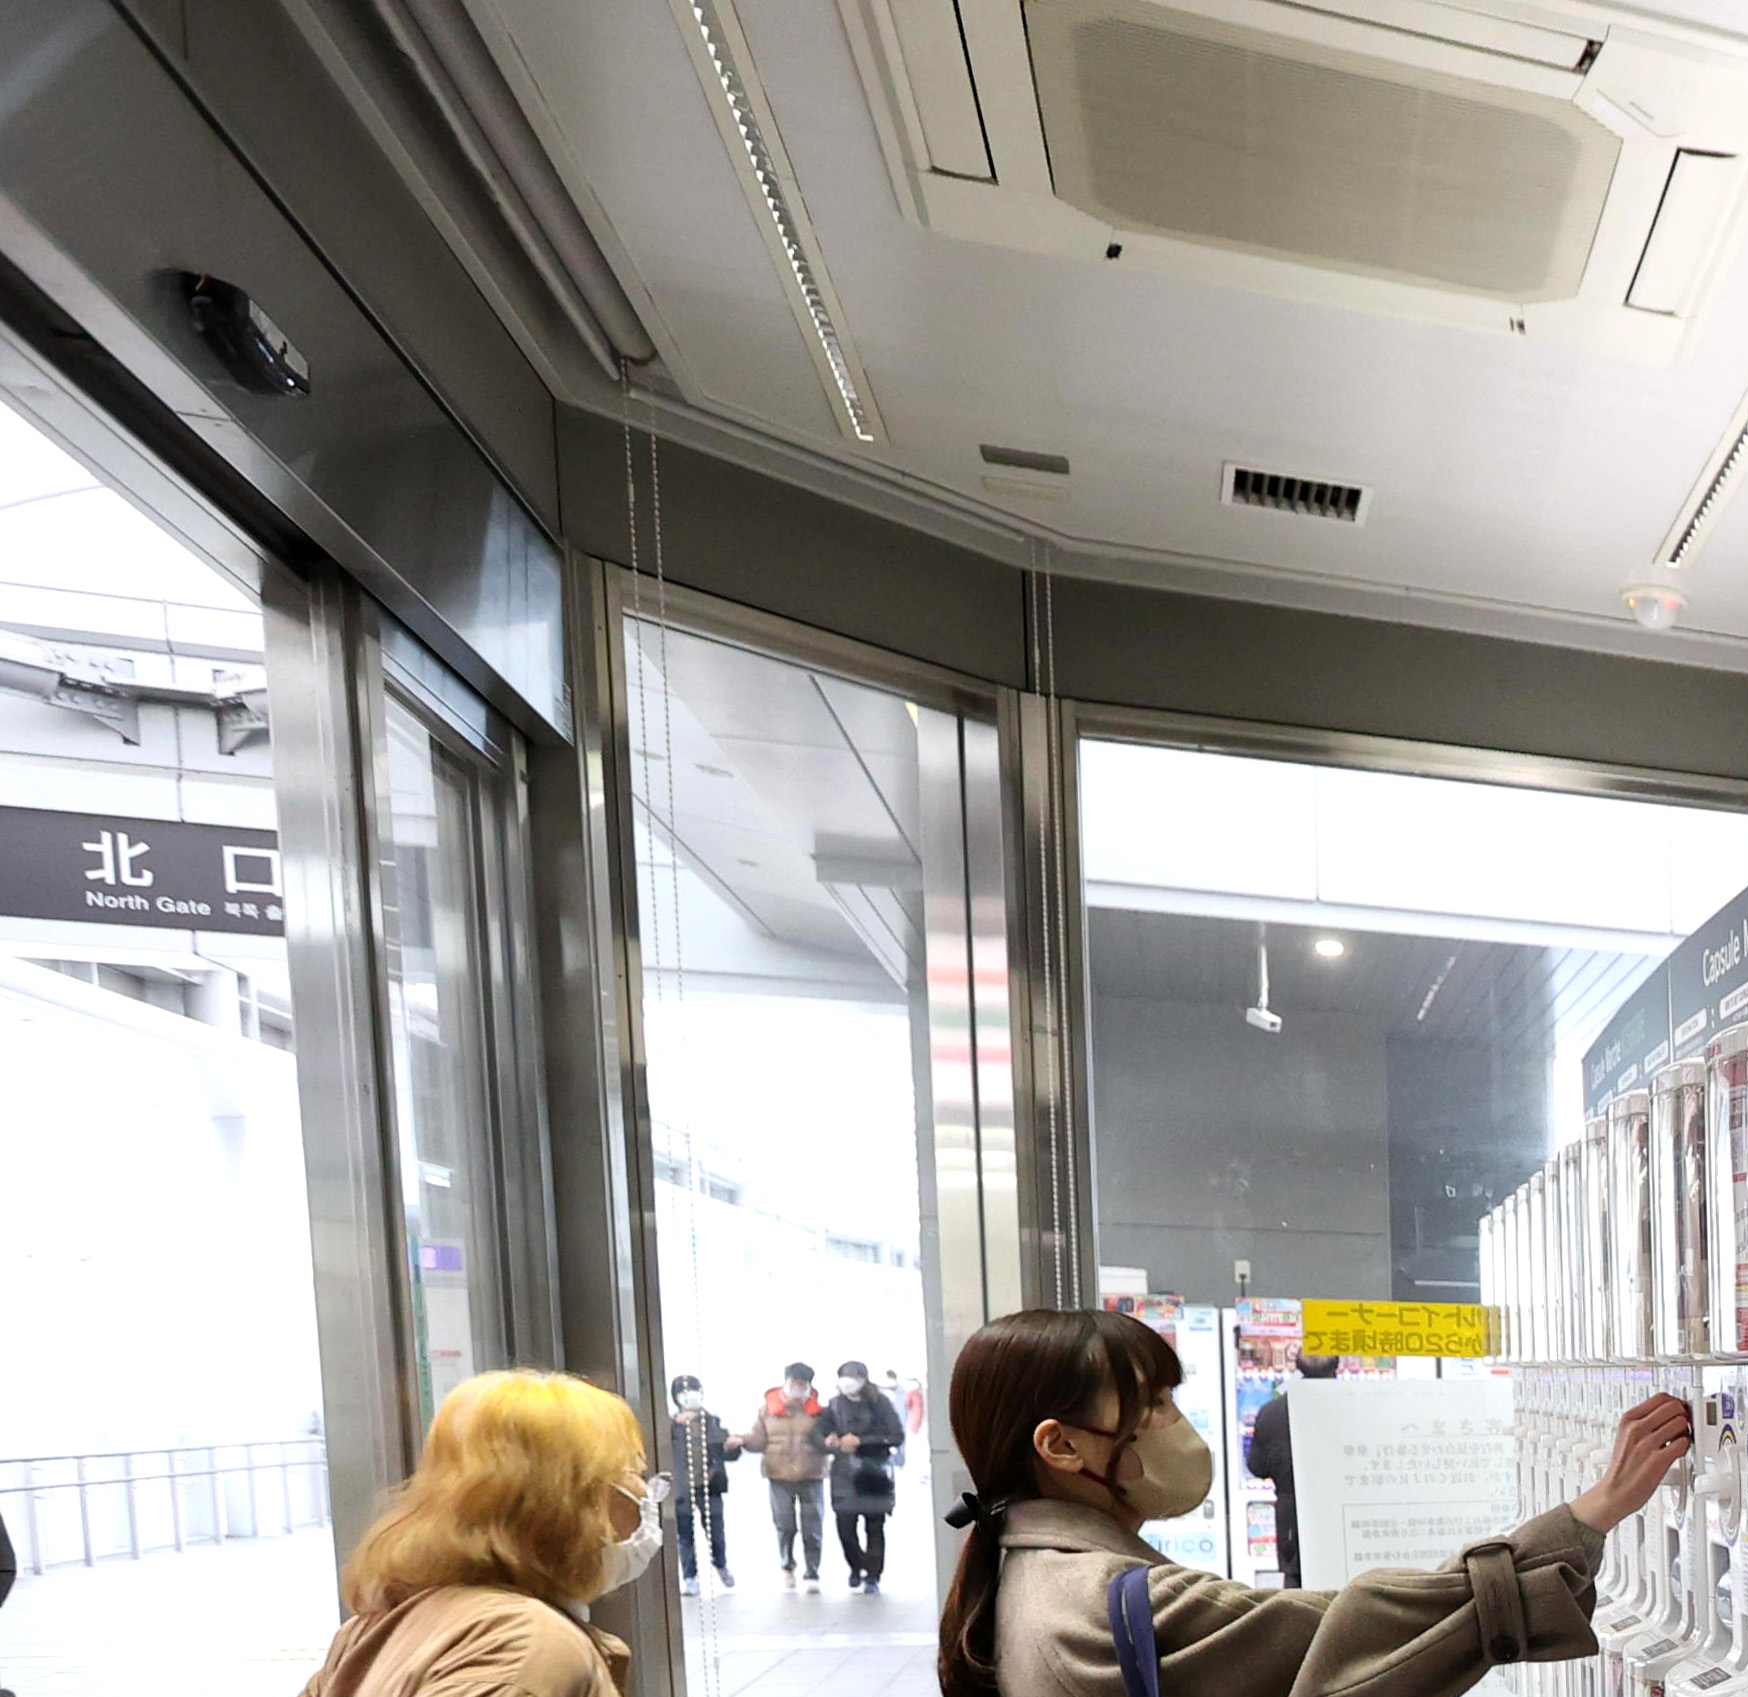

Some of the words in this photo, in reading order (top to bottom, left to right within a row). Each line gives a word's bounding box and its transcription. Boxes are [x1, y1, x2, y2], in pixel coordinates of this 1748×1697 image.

[82, 831, 283, 898] 北口
[85, 891, 149, 911] North
[156, 896, 211, 916] Gate
[1703, 931, 1741, 987] Capsule
